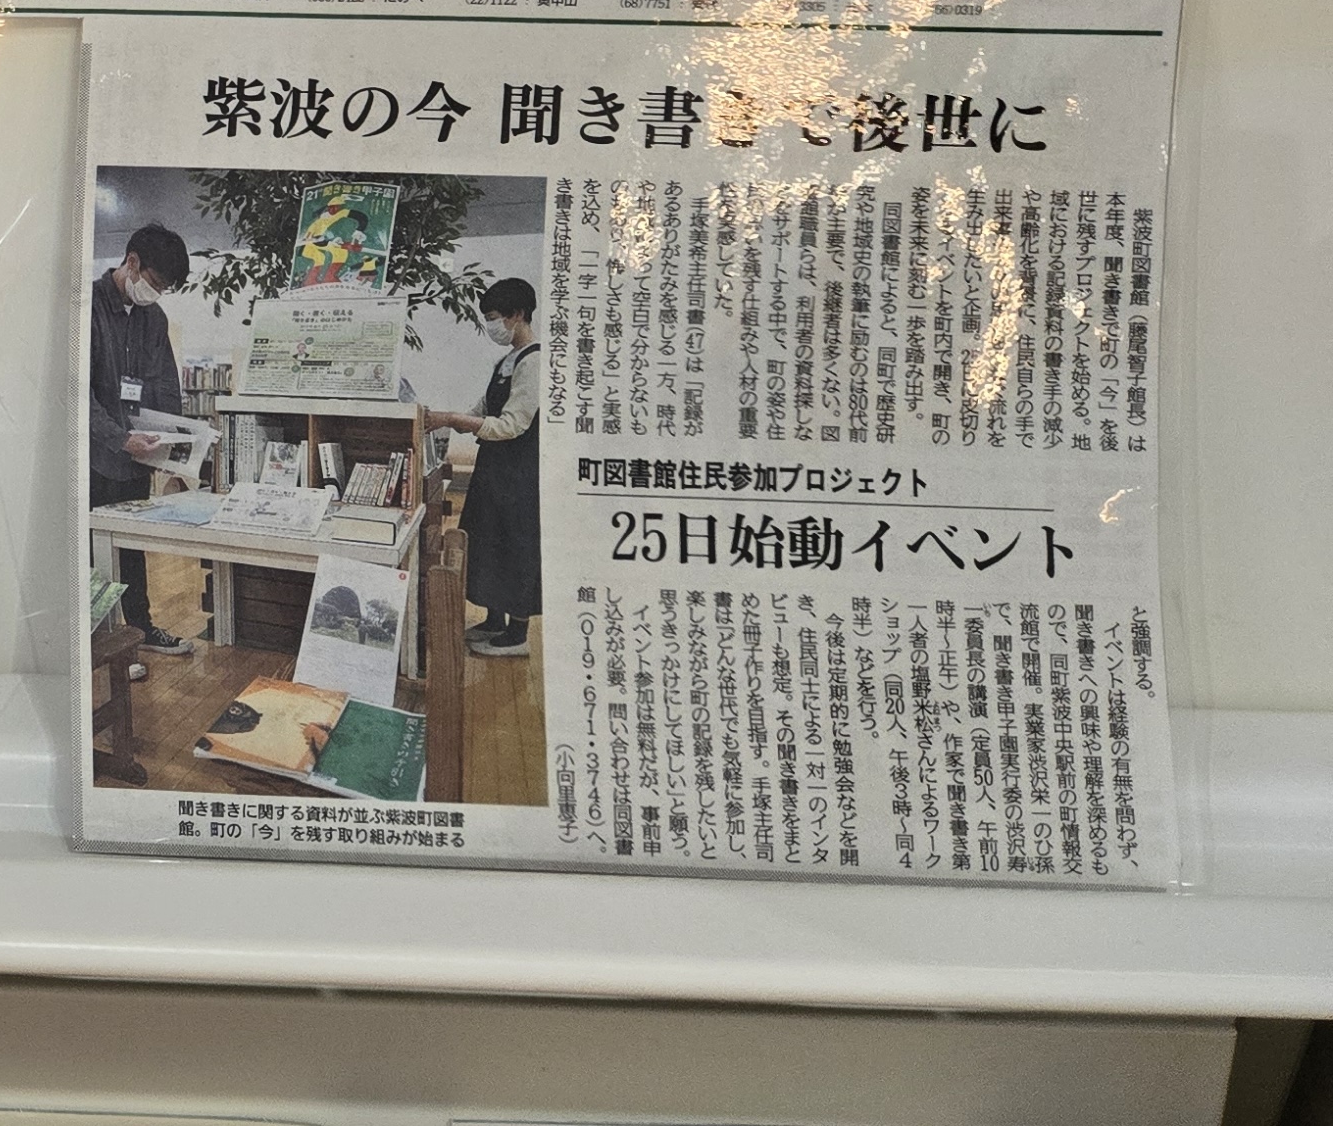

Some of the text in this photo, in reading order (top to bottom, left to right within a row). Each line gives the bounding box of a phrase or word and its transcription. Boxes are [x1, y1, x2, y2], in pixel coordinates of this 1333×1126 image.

[201, 76, 471, 144] 紫波の今
[577, 457, 928, 498] 町図書館住民参加プロジェクト
[611, 511, 1074, 578] 25日始動イベント
